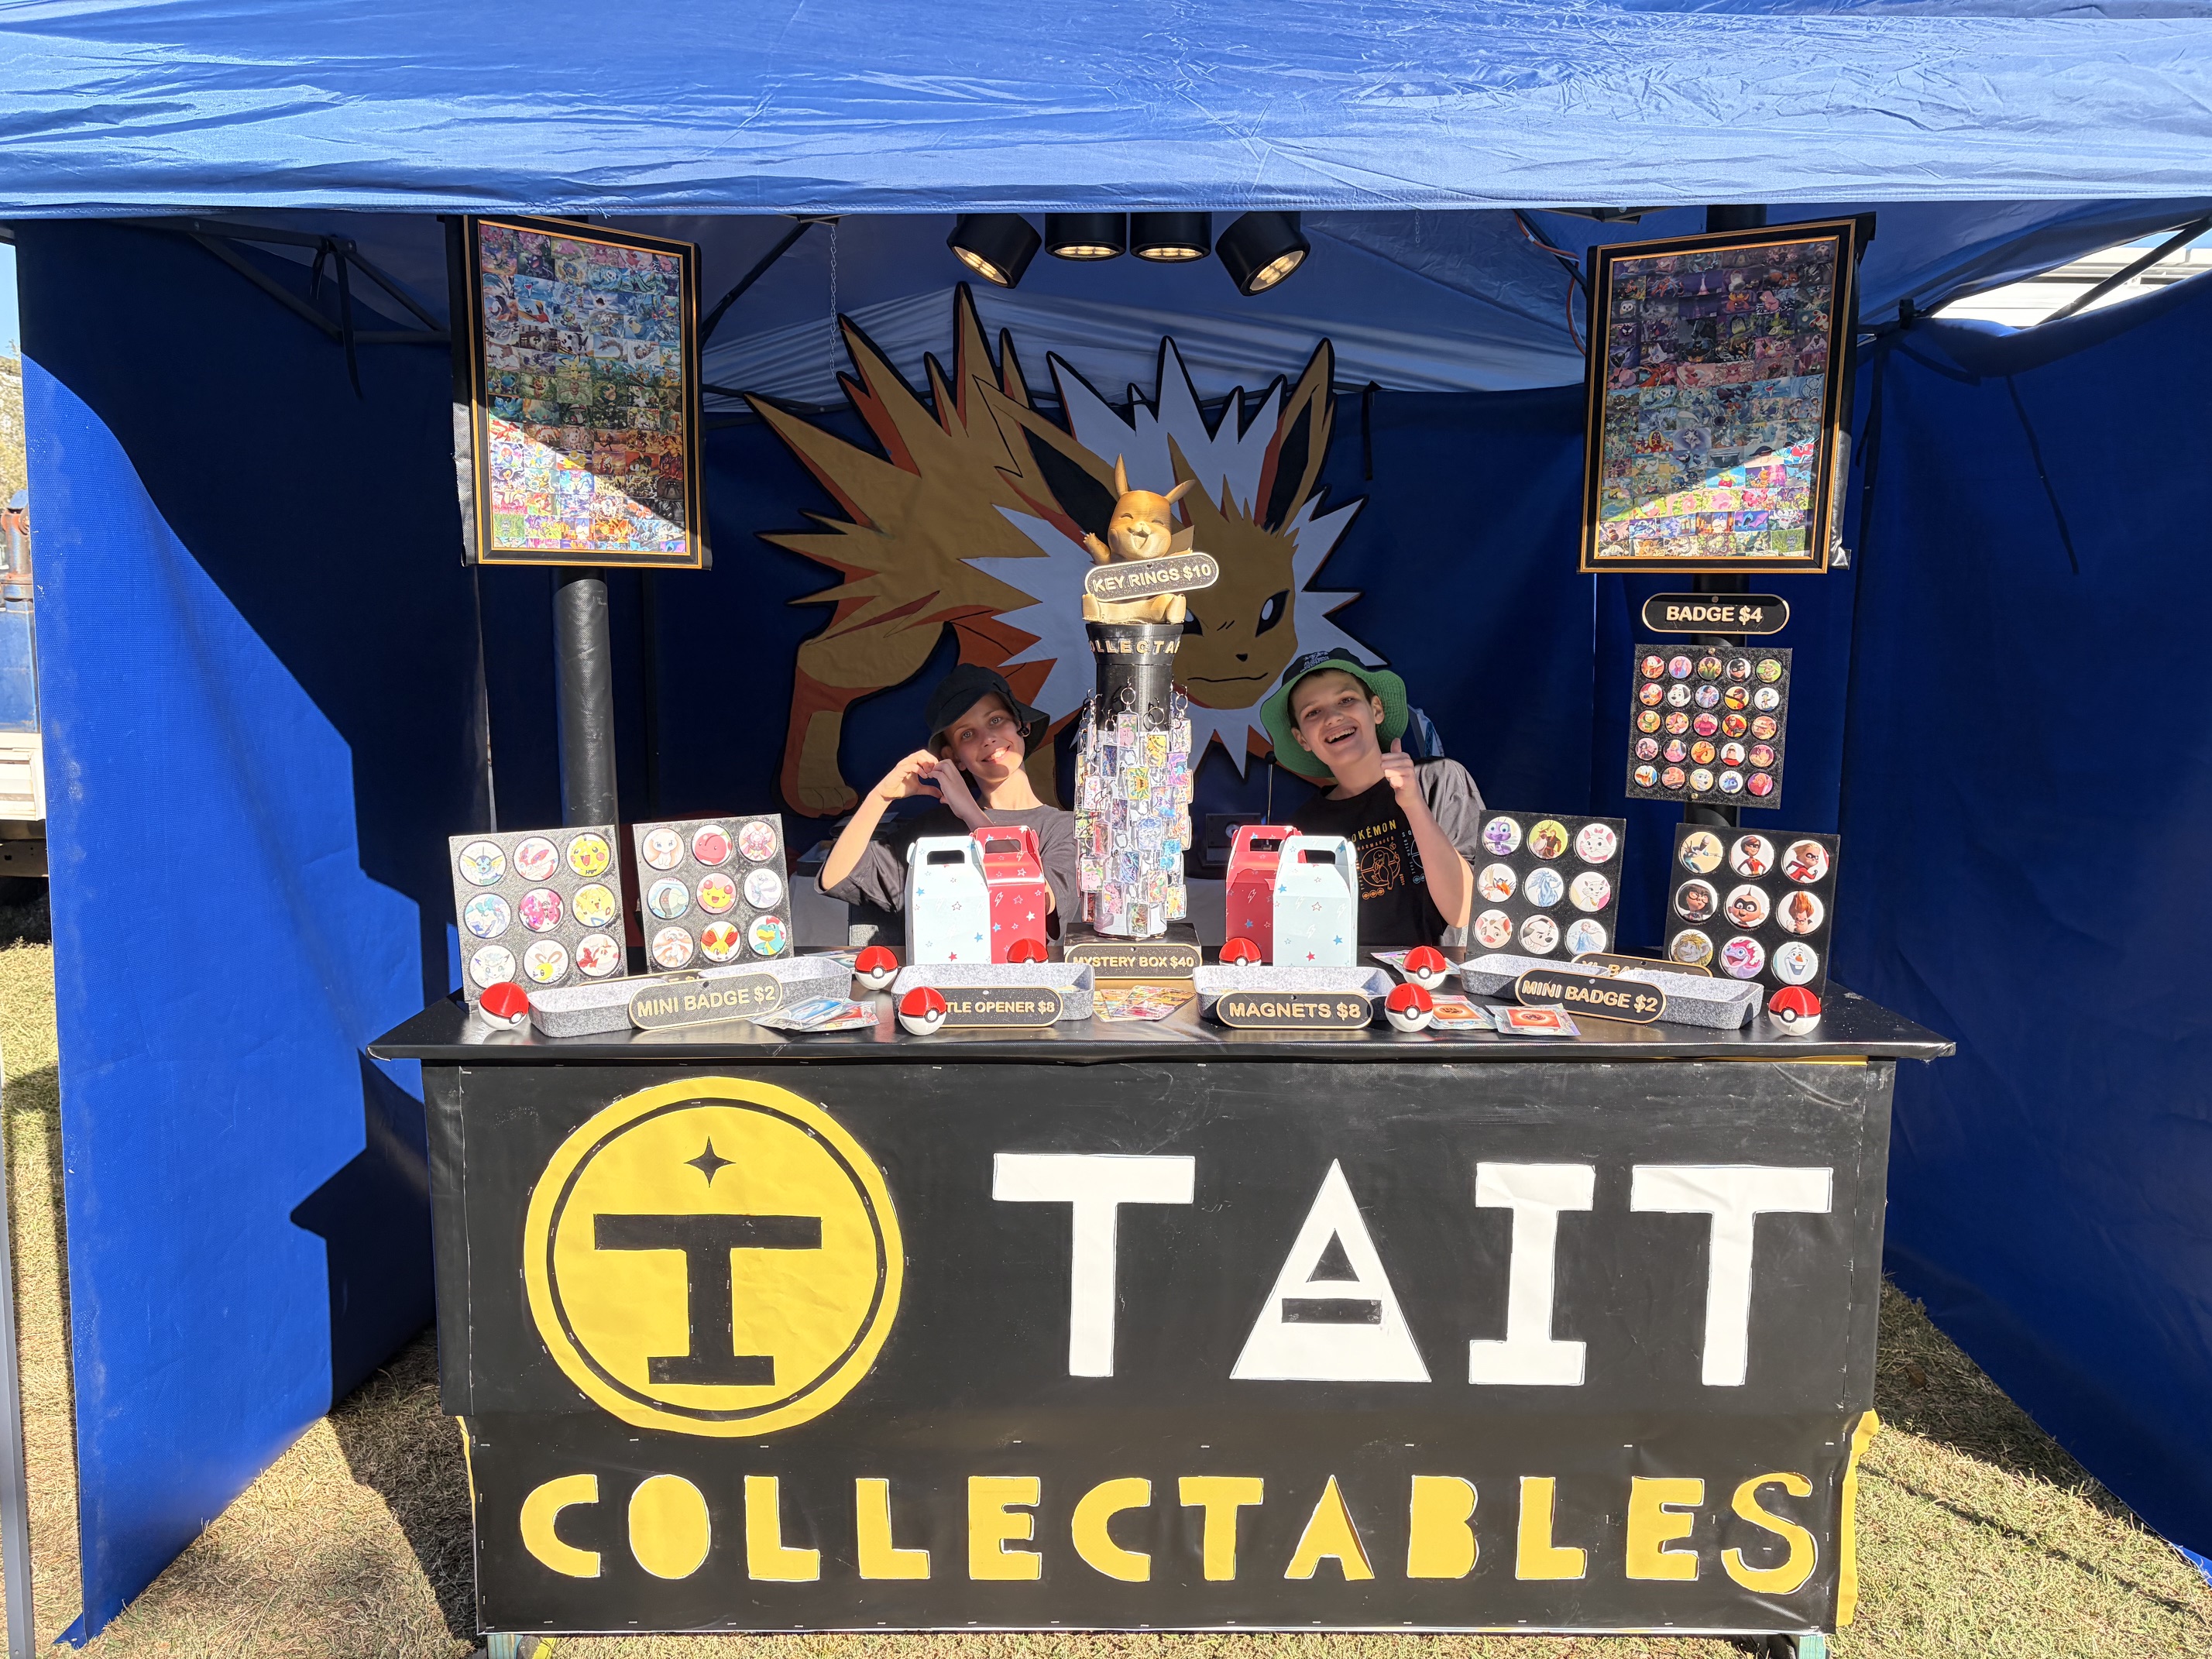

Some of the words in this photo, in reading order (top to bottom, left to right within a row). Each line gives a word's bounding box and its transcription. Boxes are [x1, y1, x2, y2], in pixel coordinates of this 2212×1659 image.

[1092, 576, 1125, 592] KEY
[1128, 568, 1180, 587] RINGS
[1182, 564, 1211, 582] $10
[1666, 606, 1735, 622] BADGE
[1738, 605, 1764, 626] $4
[1351, 819, 1396, 843] OKÉMON
[1073, 957, 1136, 968] MYSTERY
[1139, 957, 1168, 968] BOX
[1170, 955, 1195, 969] $40
[637, 998, 678, 1018] MINI
[684, 988, 750, 1012] BADGE
[754, 985, 776, 1005] $2
[946, 1001, 972, 1014] TLE
[974, 1001, 1035, 1014] OPENER
[1038, 999, 1056, 1015] $8
[1521, 980, 1562, 999] MINI
[1565, 985, 1632, 1008] BADGE
[1633, 994, 1658, 1013] $2
[1229, 1002, 1331, 1018] MAGNETS
[1336, 1001, 1362, 1022] $8
[992, 1152, 1834, 1388] TAIT
[519, 1471, 1817, 1597] COLLECTABLES
